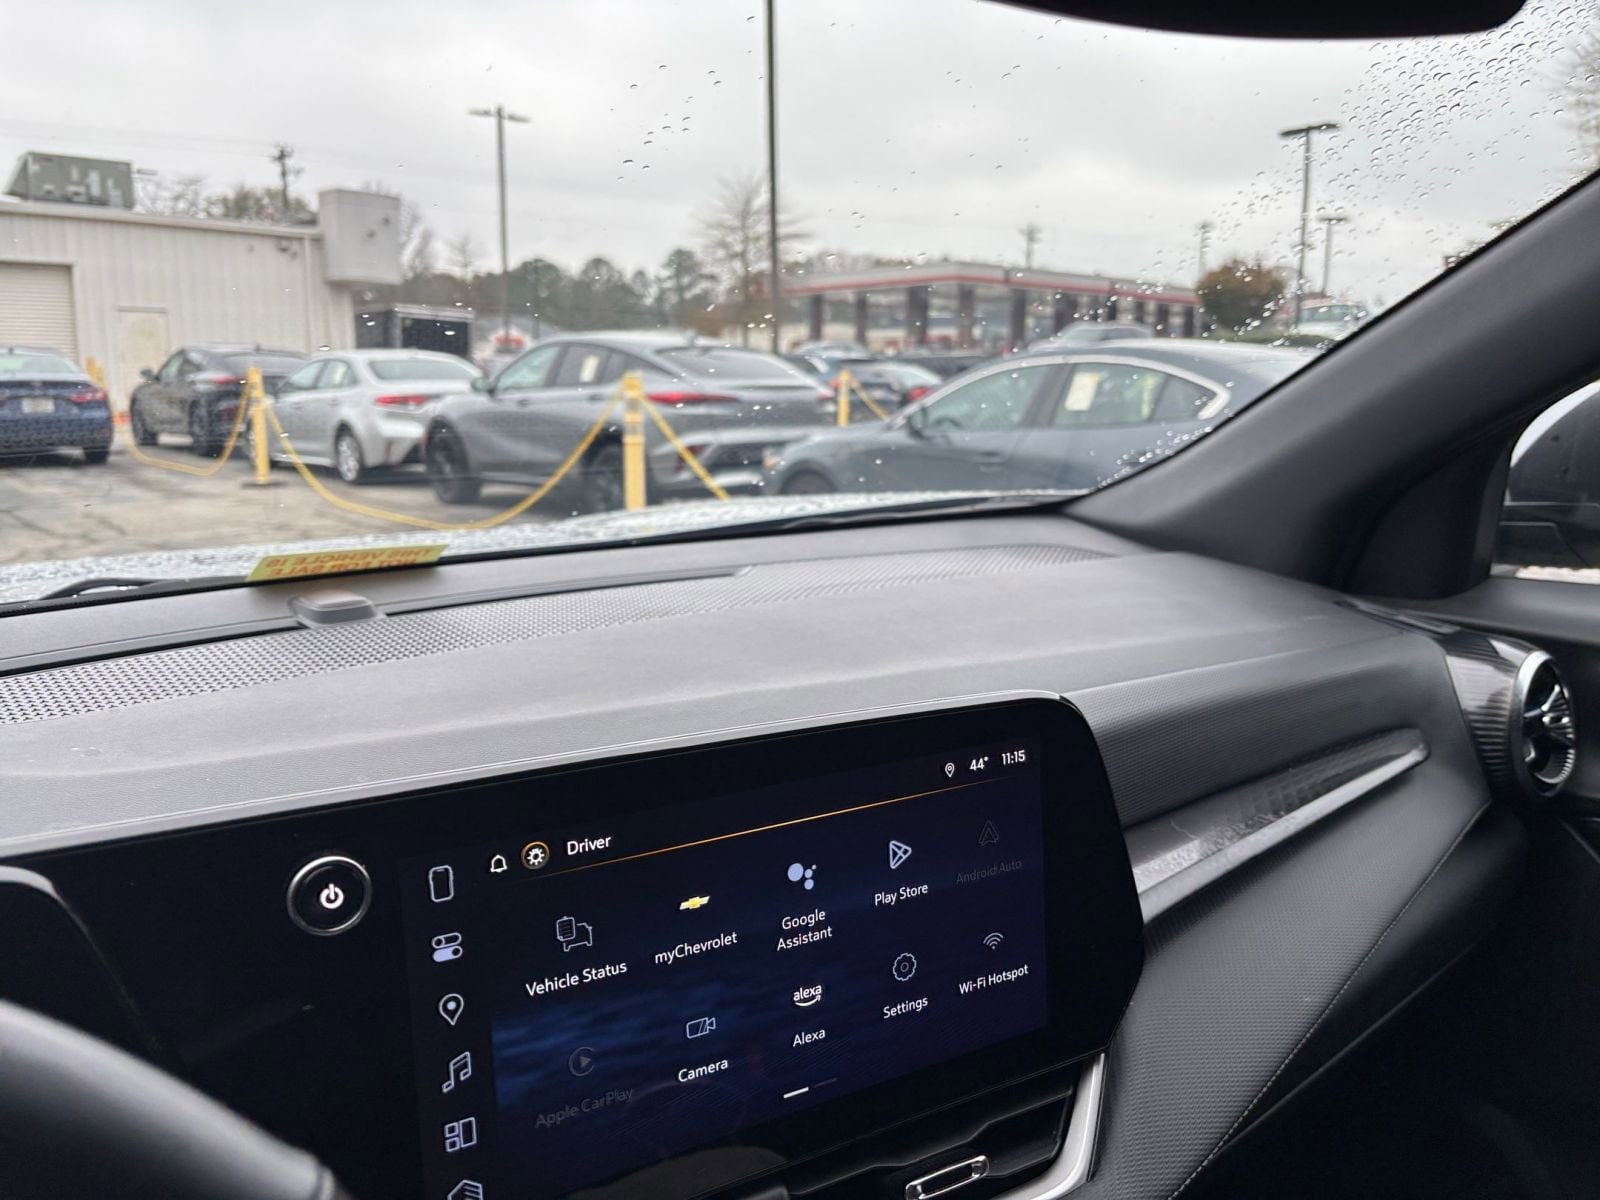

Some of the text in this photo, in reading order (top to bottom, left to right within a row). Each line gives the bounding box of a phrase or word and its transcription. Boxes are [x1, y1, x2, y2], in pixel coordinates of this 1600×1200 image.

[969, 749, 1026, 771] 44° 11:15
[566, 835, 611, 855] Driver
[956, 859, 1022, 885] Android Auto
[874, 882, 928, 906] Play Store
[781, 908, 826, 931] Google
[654, 931, 738, 965] myChevrolet
[777, 926, 833, 951] Assistant
[525, 961, 628, 997] Vehicle Status
[959, 964, 1029, 995] Wi-Fi Hotspot
[793, 983, 822, 1001] alexa
[883, 997, 928, 1019] Settings
[793, 1028, 826, 1047] Alexa
[678, 1057, 729, 1082] Camera
[535, 1087, 634, 1129] Apple CarPlay
